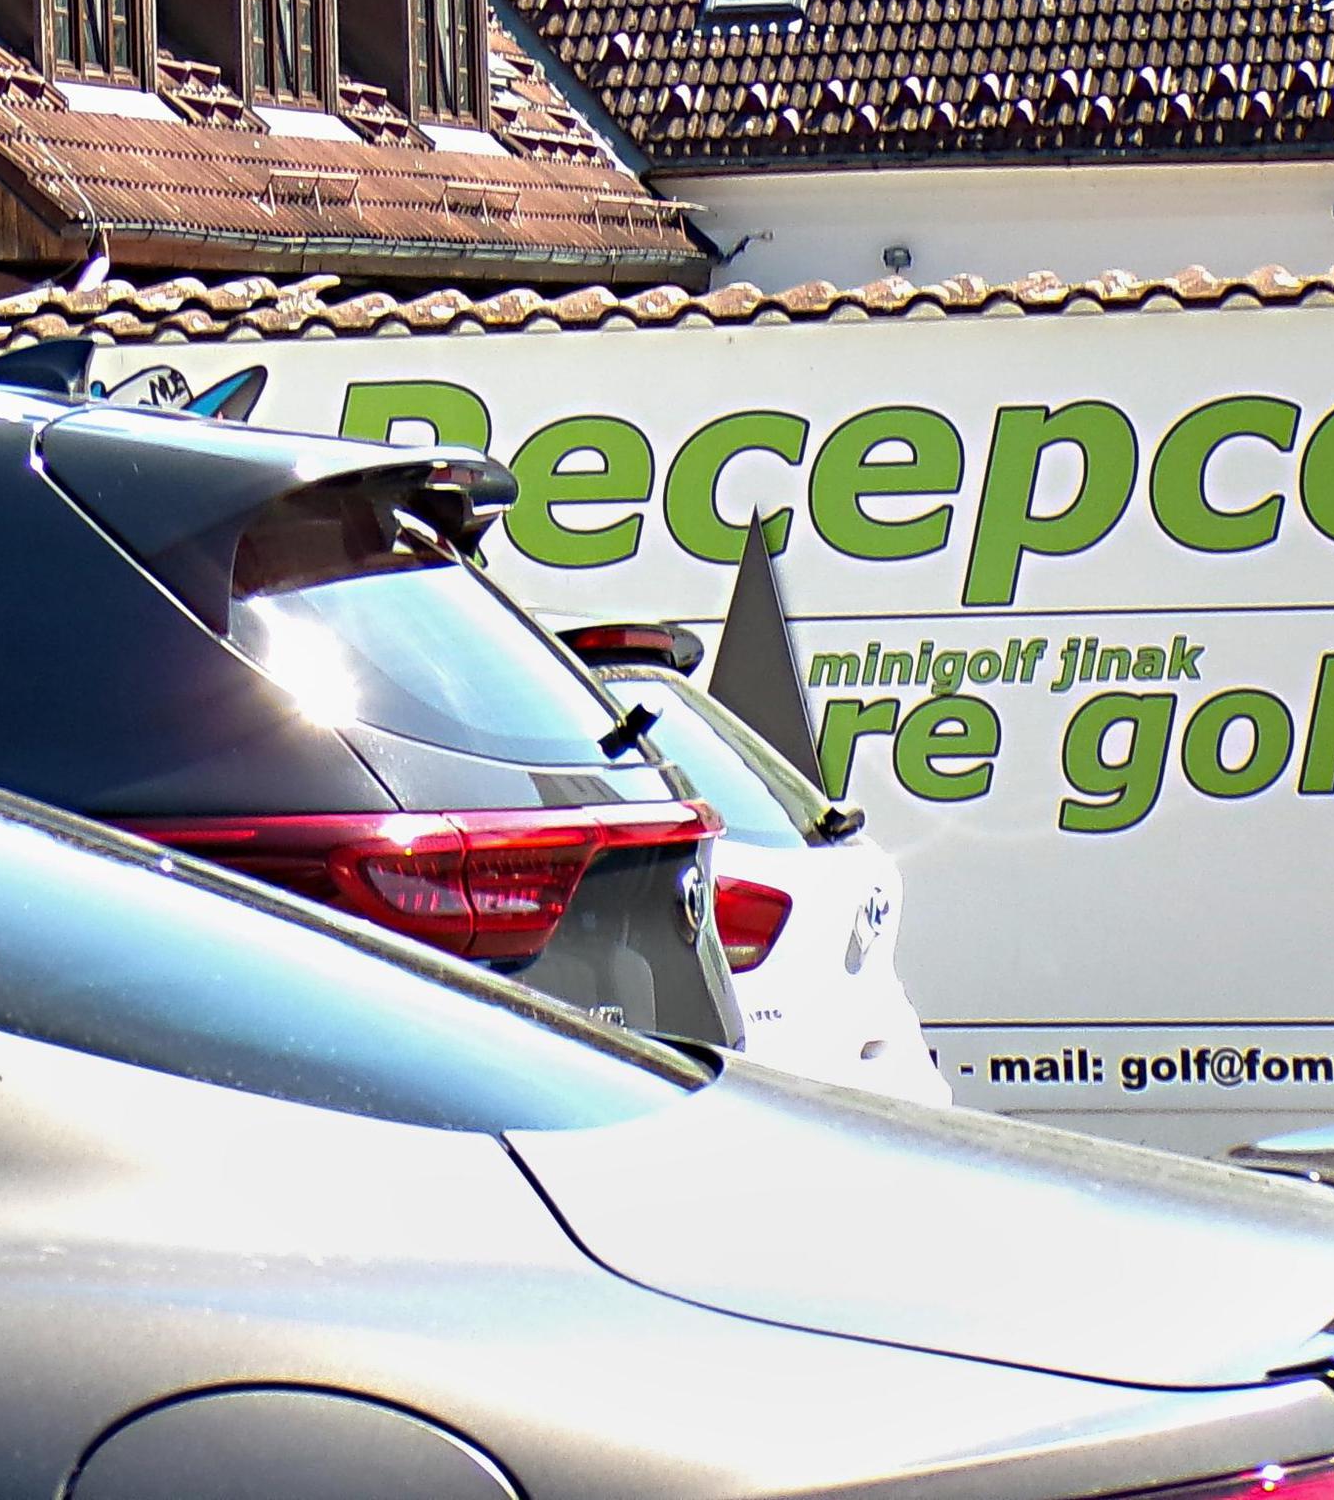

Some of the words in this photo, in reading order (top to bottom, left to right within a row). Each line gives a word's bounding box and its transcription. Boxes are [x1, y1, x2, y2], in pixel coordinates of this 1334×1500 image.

[808, 638, 1049, 694] minigolf
[1050, 635, 1204, 692] jinak
[990, 1048, 1103, 1083] mail:
